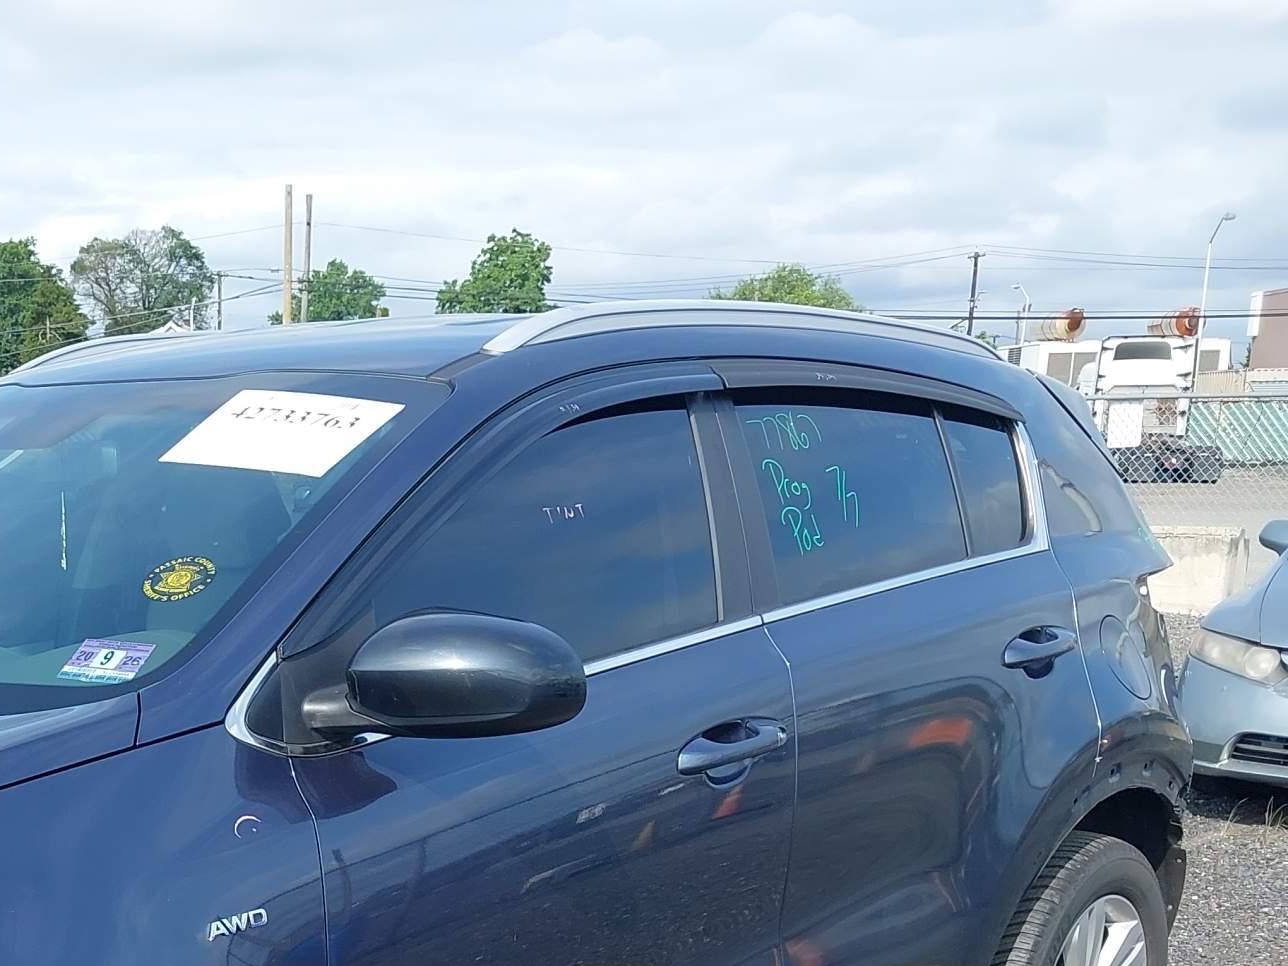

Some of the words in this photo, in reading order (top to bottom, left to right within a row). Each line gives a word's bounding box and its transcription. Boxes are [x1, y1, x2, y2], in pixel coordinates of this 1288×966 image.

[231, 406, 361, 429] 42733763
[76, 650, 95, 662] 20
[100, 650, 115, 666] 9
[207, 908, 288, 942] AWD
